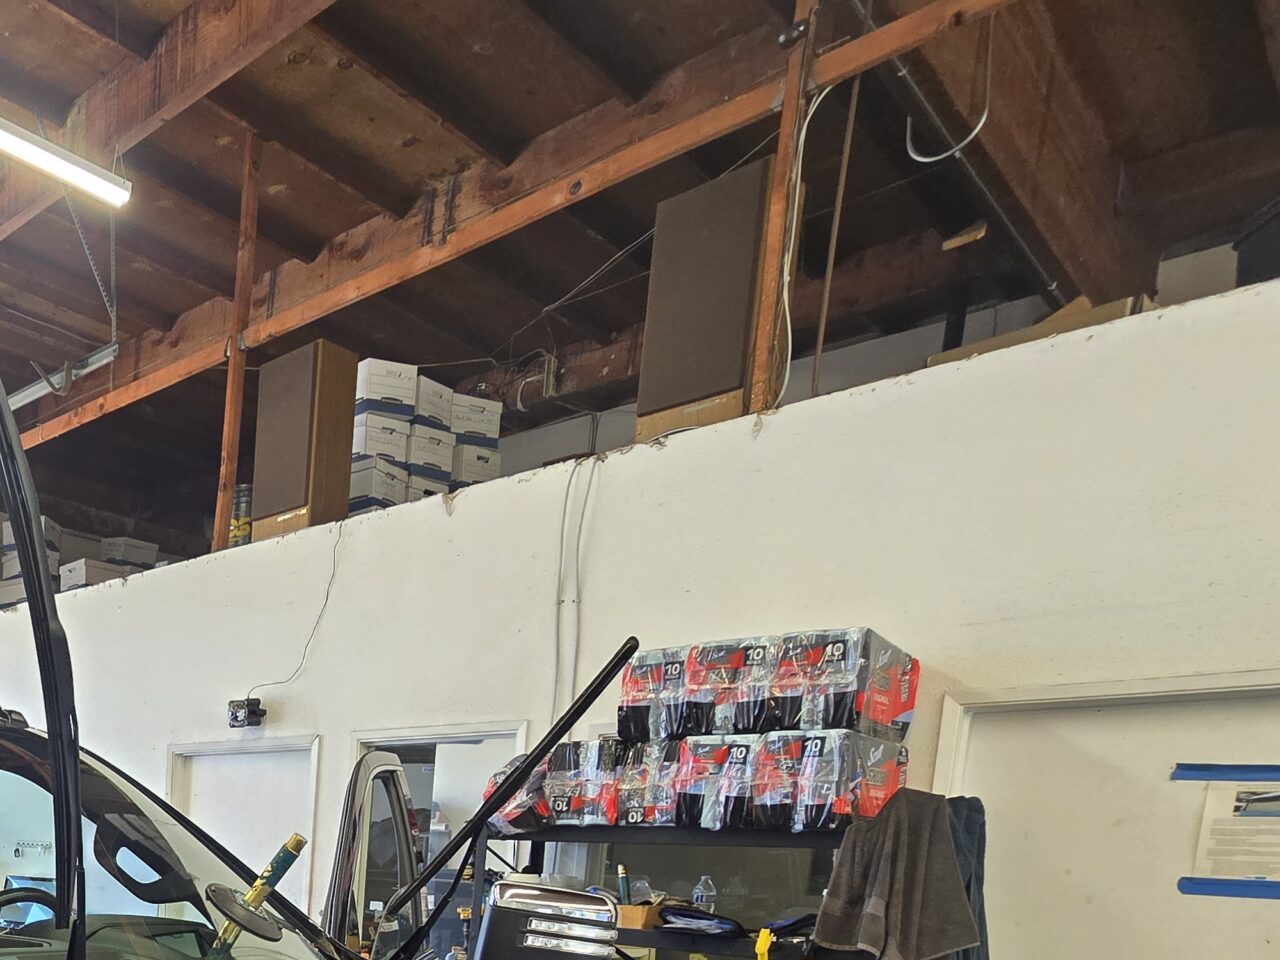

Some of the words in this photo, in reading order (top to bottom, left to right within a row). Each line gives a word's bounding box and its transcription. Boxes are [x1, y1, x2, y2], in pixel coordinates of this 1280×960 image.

[746, 648, 764, 660] 10
[825, 643, 844, 656] 10
[665, 663, 680, 675] 10
[804, 739, 822, 753] 10
[730, 746, 747, 759] 10
[554, 800, 569, 812] 10
[627, 812, 644, 824] 10
